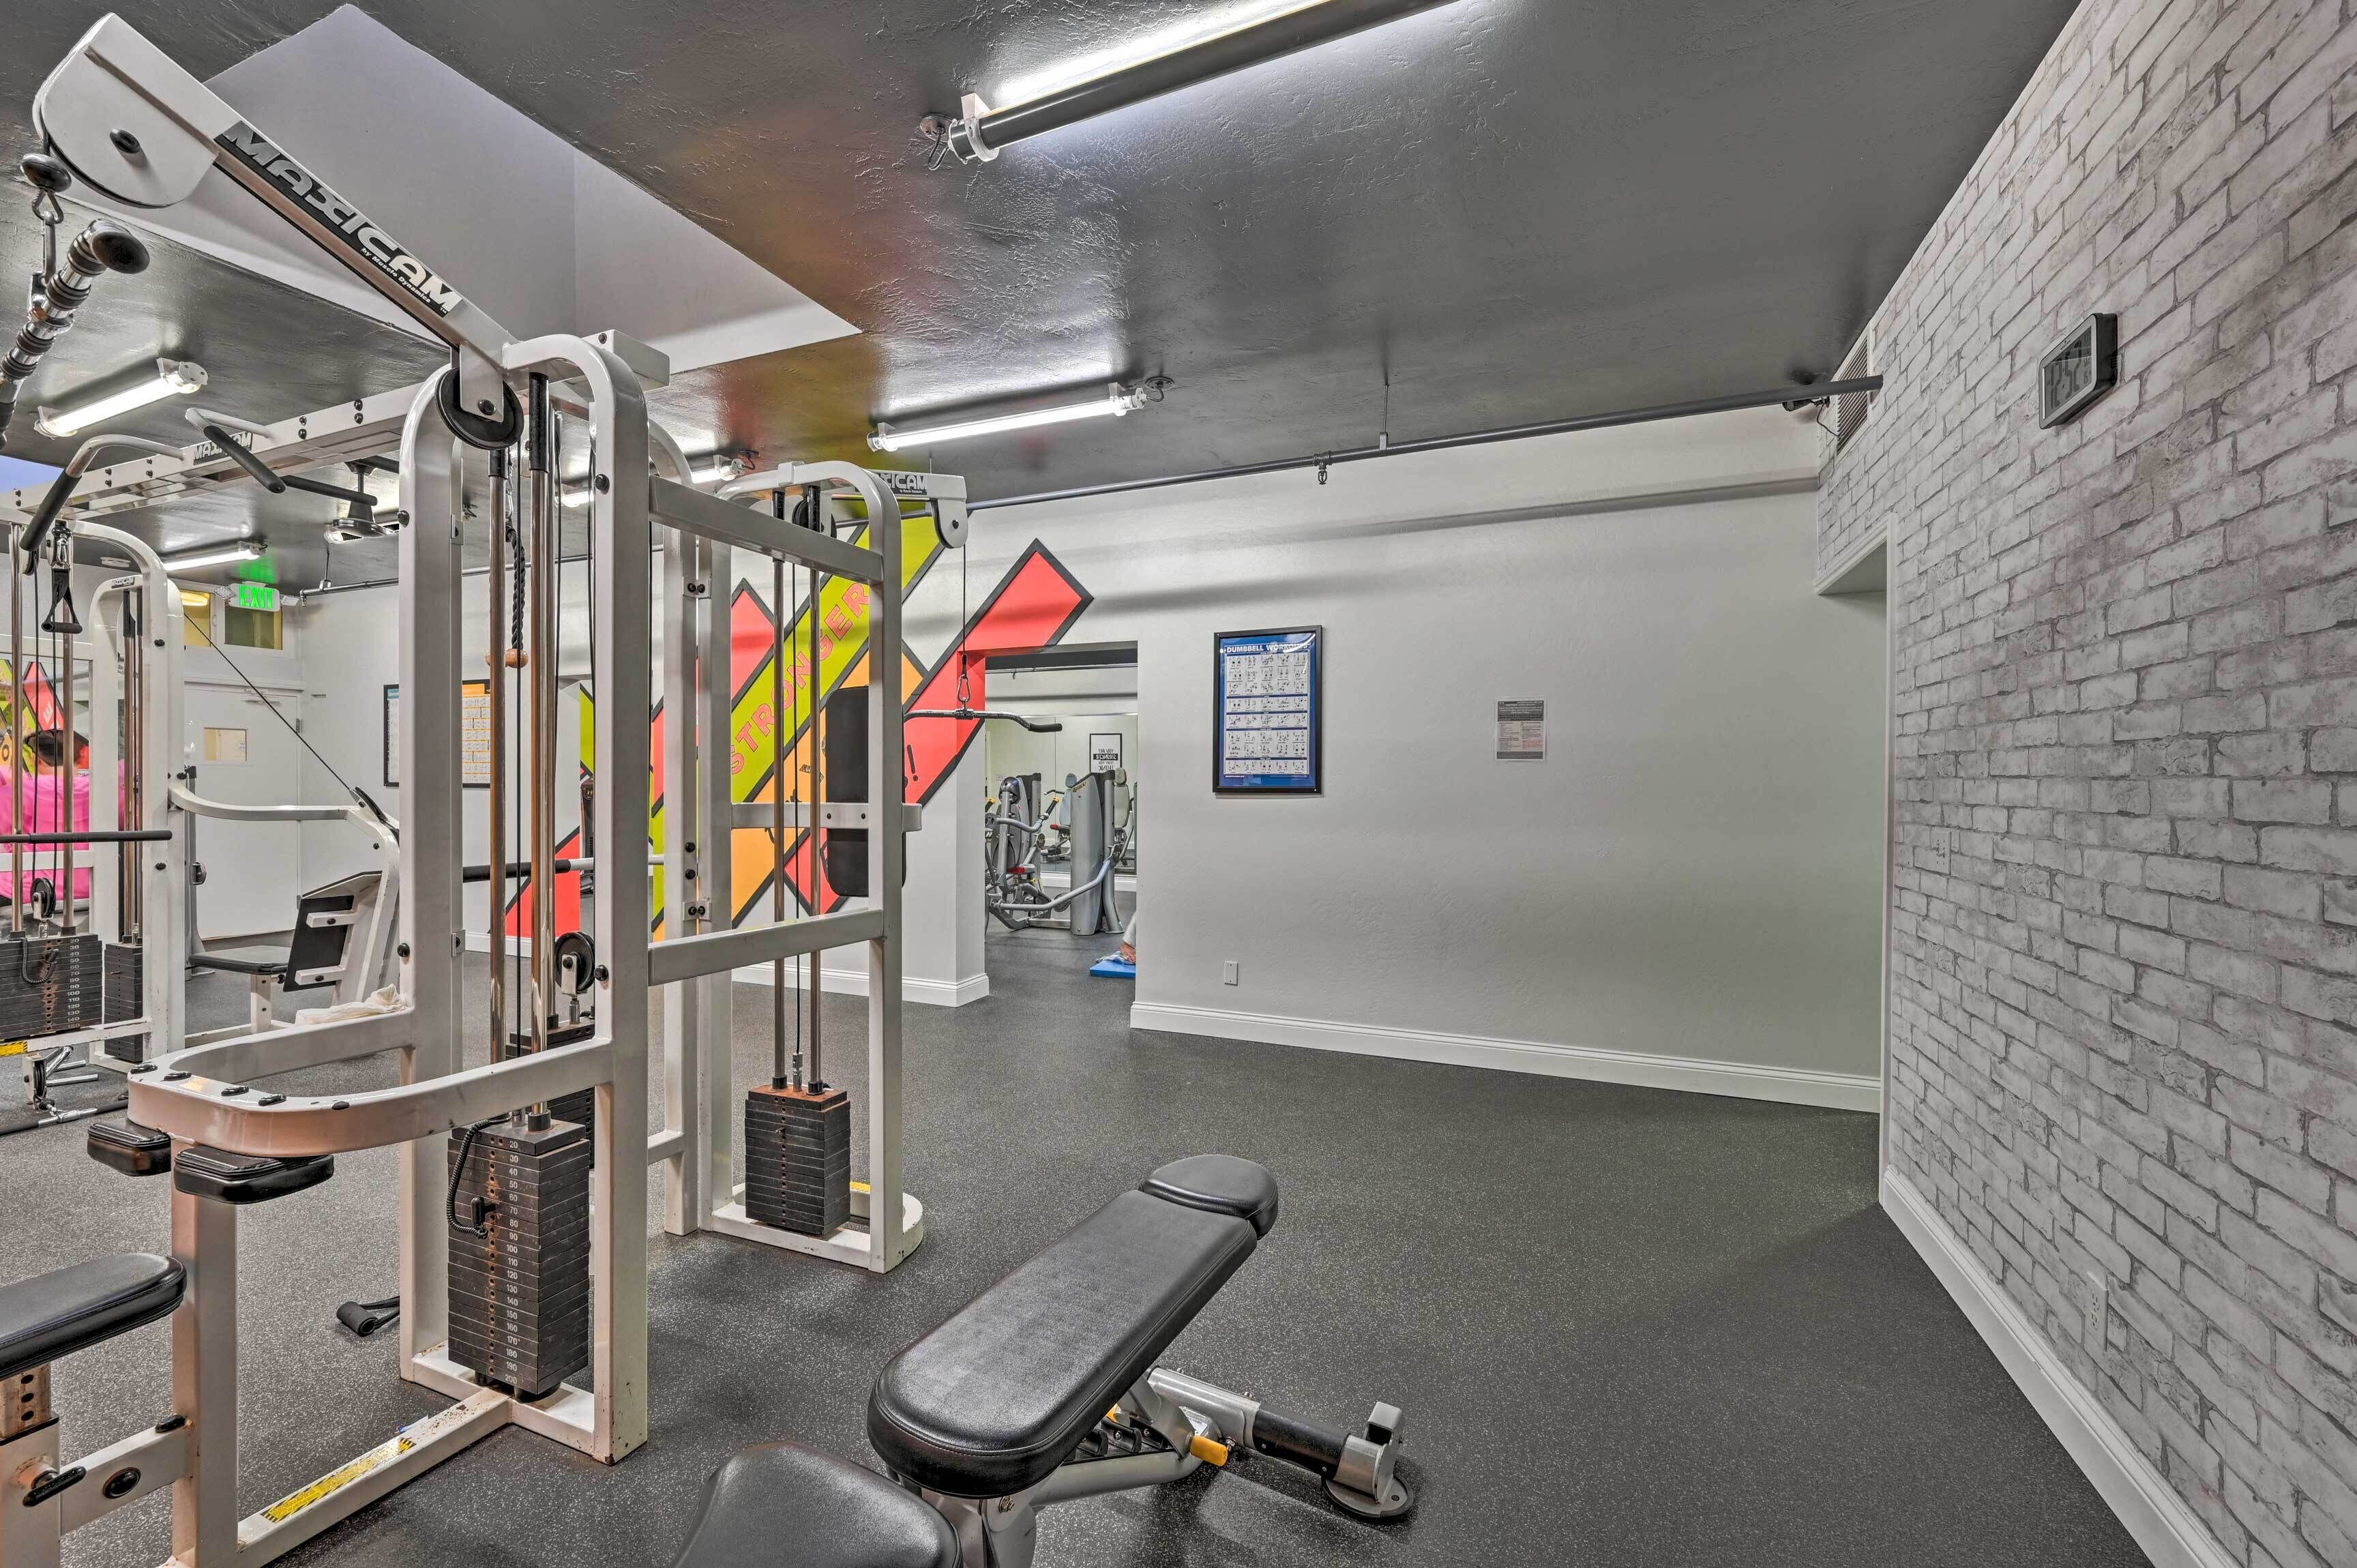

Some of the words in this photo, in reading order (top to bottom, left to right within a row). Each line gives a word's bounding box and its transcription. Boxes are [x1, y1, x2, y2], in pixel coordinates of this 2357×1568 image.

[222, 121, 463, 312] MAXICAM
[361, 248, 372, 257] by
[372, 254, 398, 278] Muscle
[398, 276, 431, 304] Dynamics
[240, 585, 274, 609] EXIT
[509, 1140, 518, 1149] 20
[509, 1155, 518, 1163] 30
[509, 1168, 518, 1176] 40
[509, 1194, 518, 1202] 60
[509, 1207, 518, 1215] 70
[509, 1219, 518, 1228] 80
[509, 1232, 518, 1241] 90
[506, 1244, 518, 1253] 100
[508, 1258, 518, 1267] 110
[507, 1270, 518, 1279] 120
[506, 1284, 518, 1294] 130
[507, 1297, 518, 1306] 140
[507, 1310, 518, 1320] 150
[506, 1323, 518, 1333] 160
[507, 1336, 518, 1345] 170
[506, 1349, 517, 1359] 180
[506, 1361, 517, 1371] 190
[505, 1374, 517, 1385] 200
